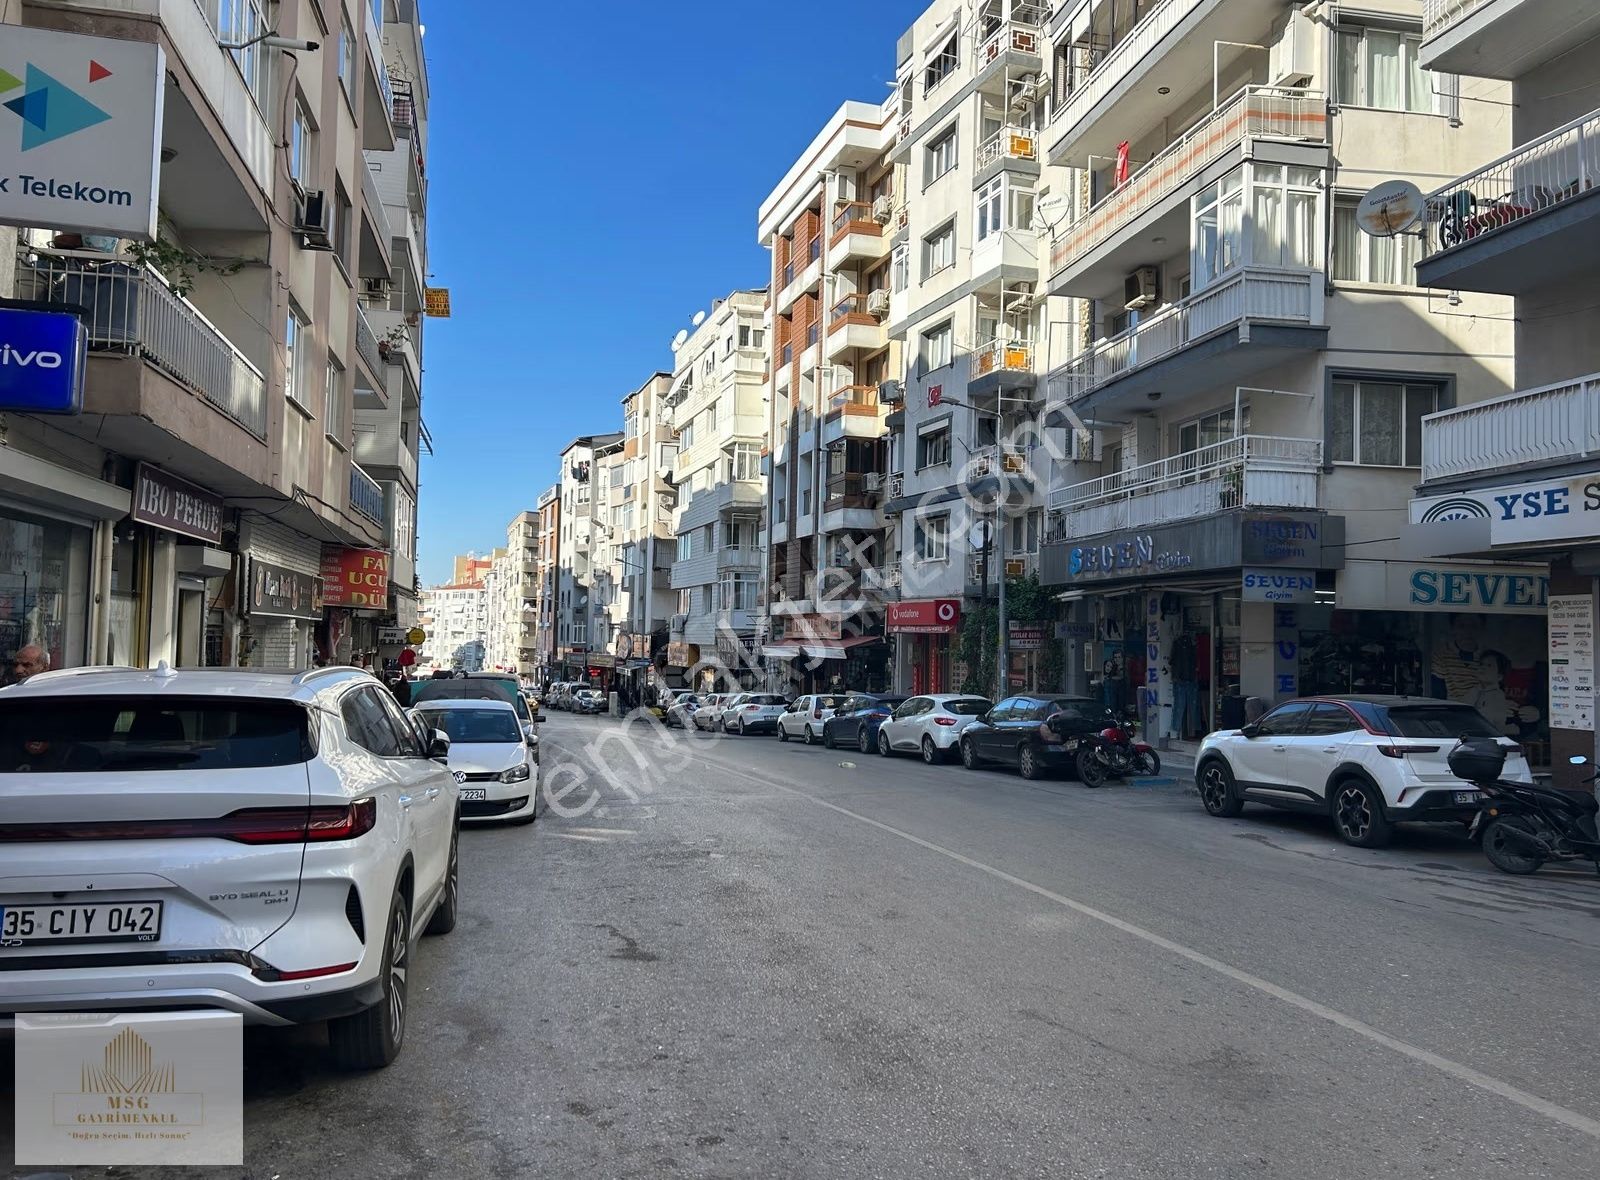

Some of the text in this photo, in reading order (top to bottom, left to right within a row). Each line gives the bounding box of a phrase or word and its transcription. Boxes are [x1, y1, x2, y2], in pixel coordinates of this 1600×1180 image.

[19, 175, 132, 206] Telekom
[1494, 487, 1570, 520] YSE
[174, 491, 220, 534] PERDE
[1244, 574, 1313, 590] SEVEN
[1265, 591, 1293, 600] Giyim
[899, 608, 919, 618] vodafone
[465, 791, 484, 800] 2234
[241, 891, 276, 899] SEAL
[4, 907, 154, 936] 35 CIY 042
